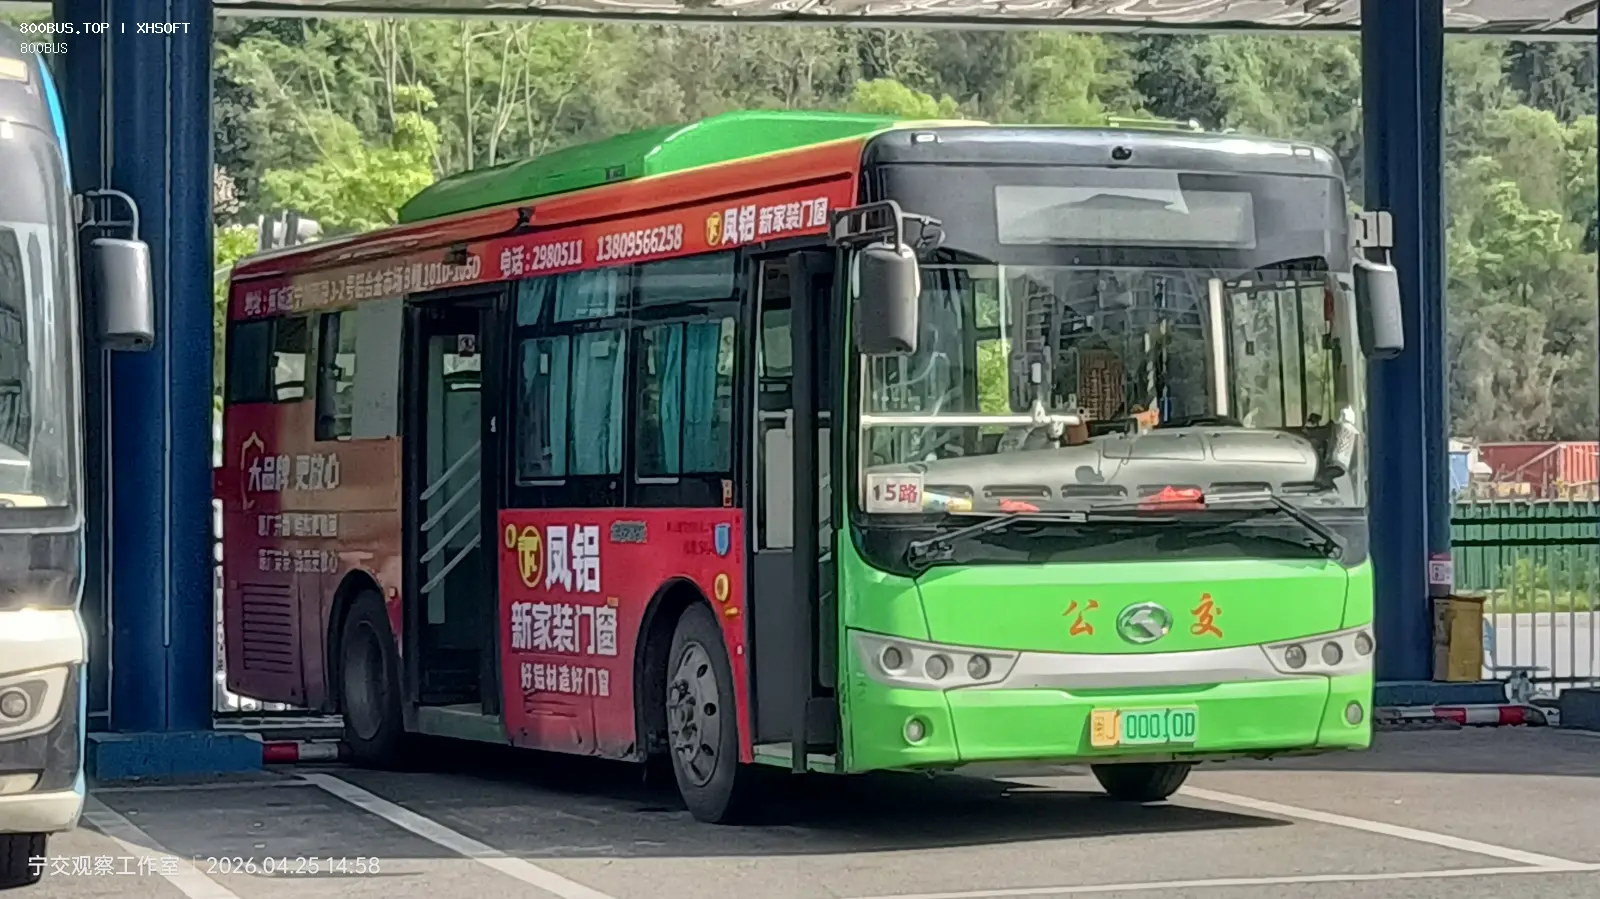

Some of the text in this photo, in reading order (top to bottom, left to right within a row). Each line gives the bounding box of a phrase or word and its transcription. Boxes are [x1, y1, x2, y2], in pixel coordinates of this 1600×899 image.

[596, 223, 683, 262] 13809566258
[721, 197, 829, 245] 凤铝 新家装门窗
[247, 452, 341, 492] 大品牌 更放心
[873, 483, 918, 503] 15路
[545, 523, 601, 592] 凤铝
[511, 601, 618, 656] 新家装门窗
[1062, 592, 1224, 638] 公 交
[520, 662, 610, 697] 好铝材造好门窗
